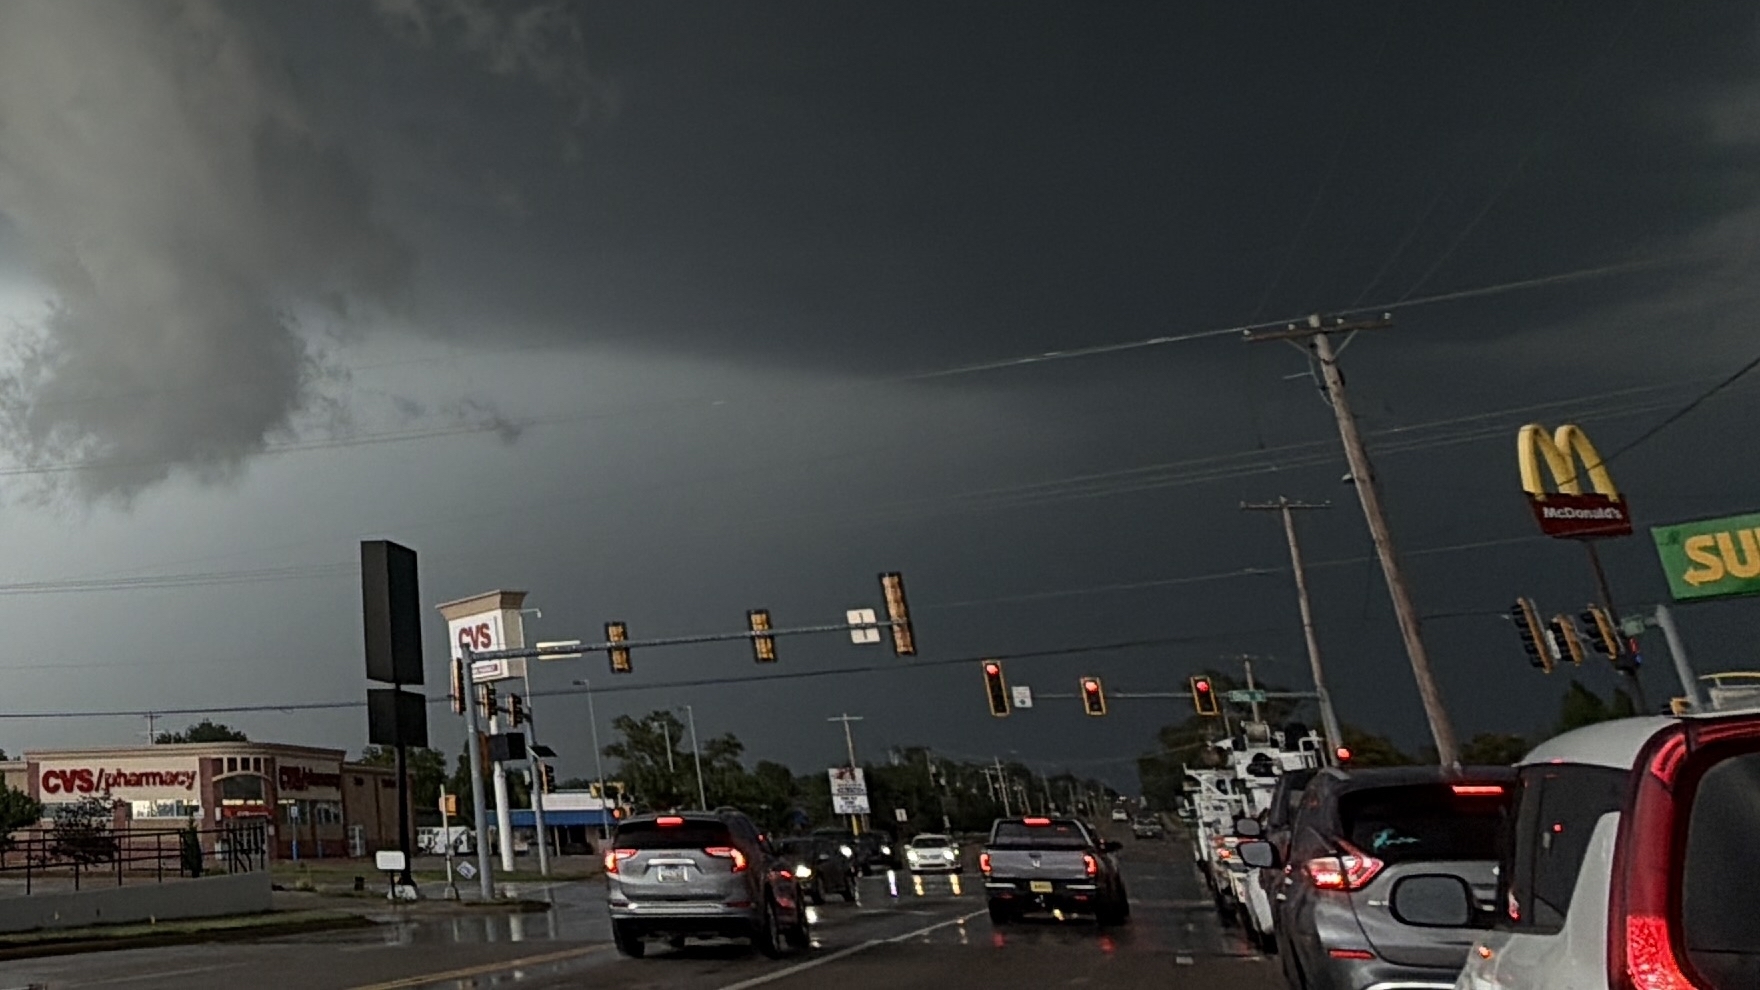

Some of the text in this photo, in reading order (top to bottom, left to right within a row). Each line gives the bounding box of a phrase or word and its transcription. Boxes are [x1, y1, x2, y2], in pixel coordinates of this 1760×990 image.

[1543, 507, 1622, 520] McDonald's
[1683, 527, 1760, 586] SU
[458, 623, 492, 650] CVS
[42, 768, 198, 795] CVS/pharmacy
